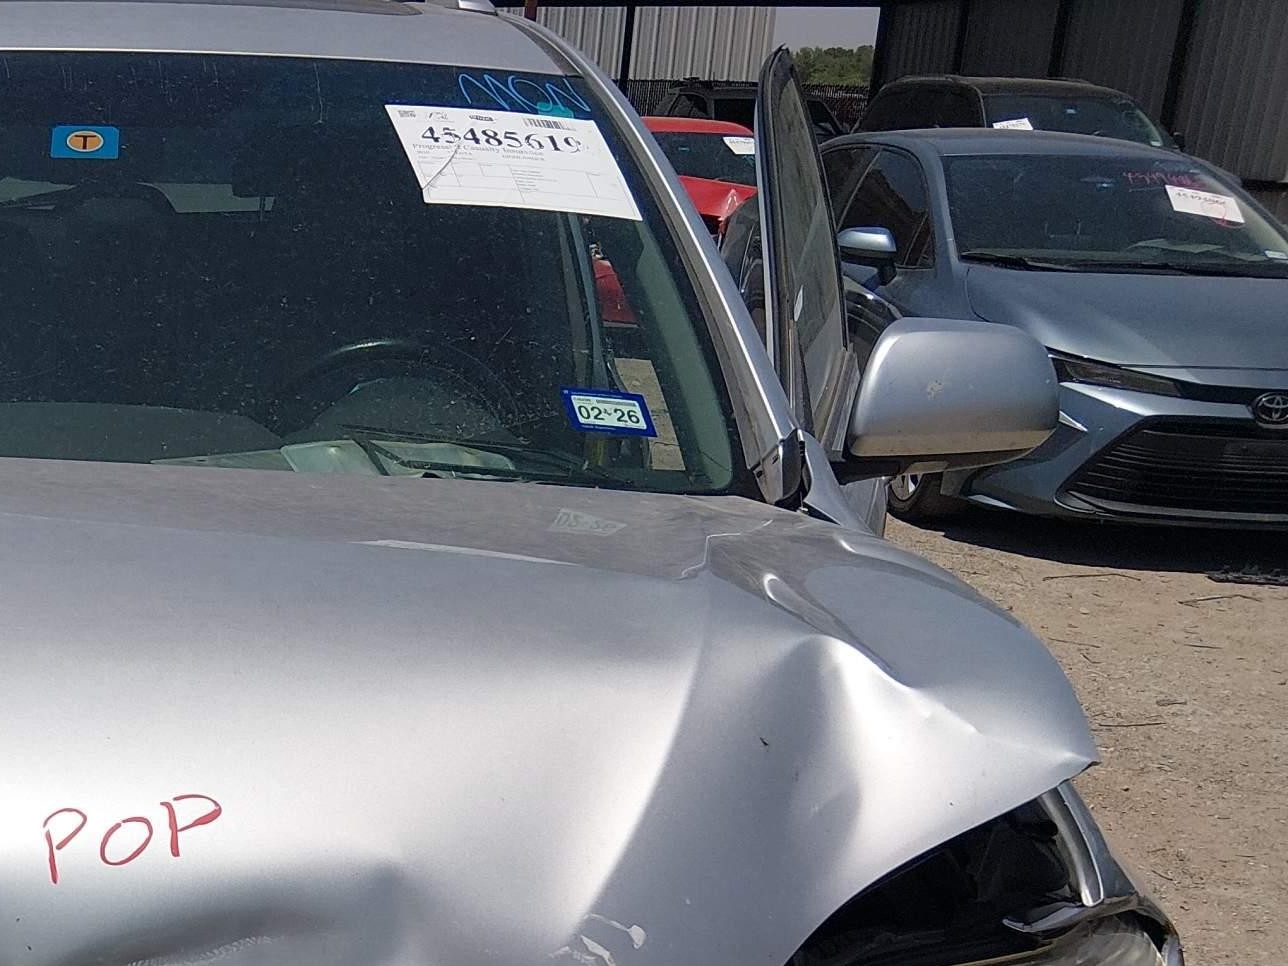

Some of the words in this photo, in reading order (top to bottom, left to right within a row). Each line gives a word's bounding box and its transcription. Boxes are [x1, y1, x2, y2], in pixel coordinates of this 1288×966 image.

[74, 134, 97, 150] T
[420, 125, 582, 154] 45485619
[42, 794, 222, 885] POP
